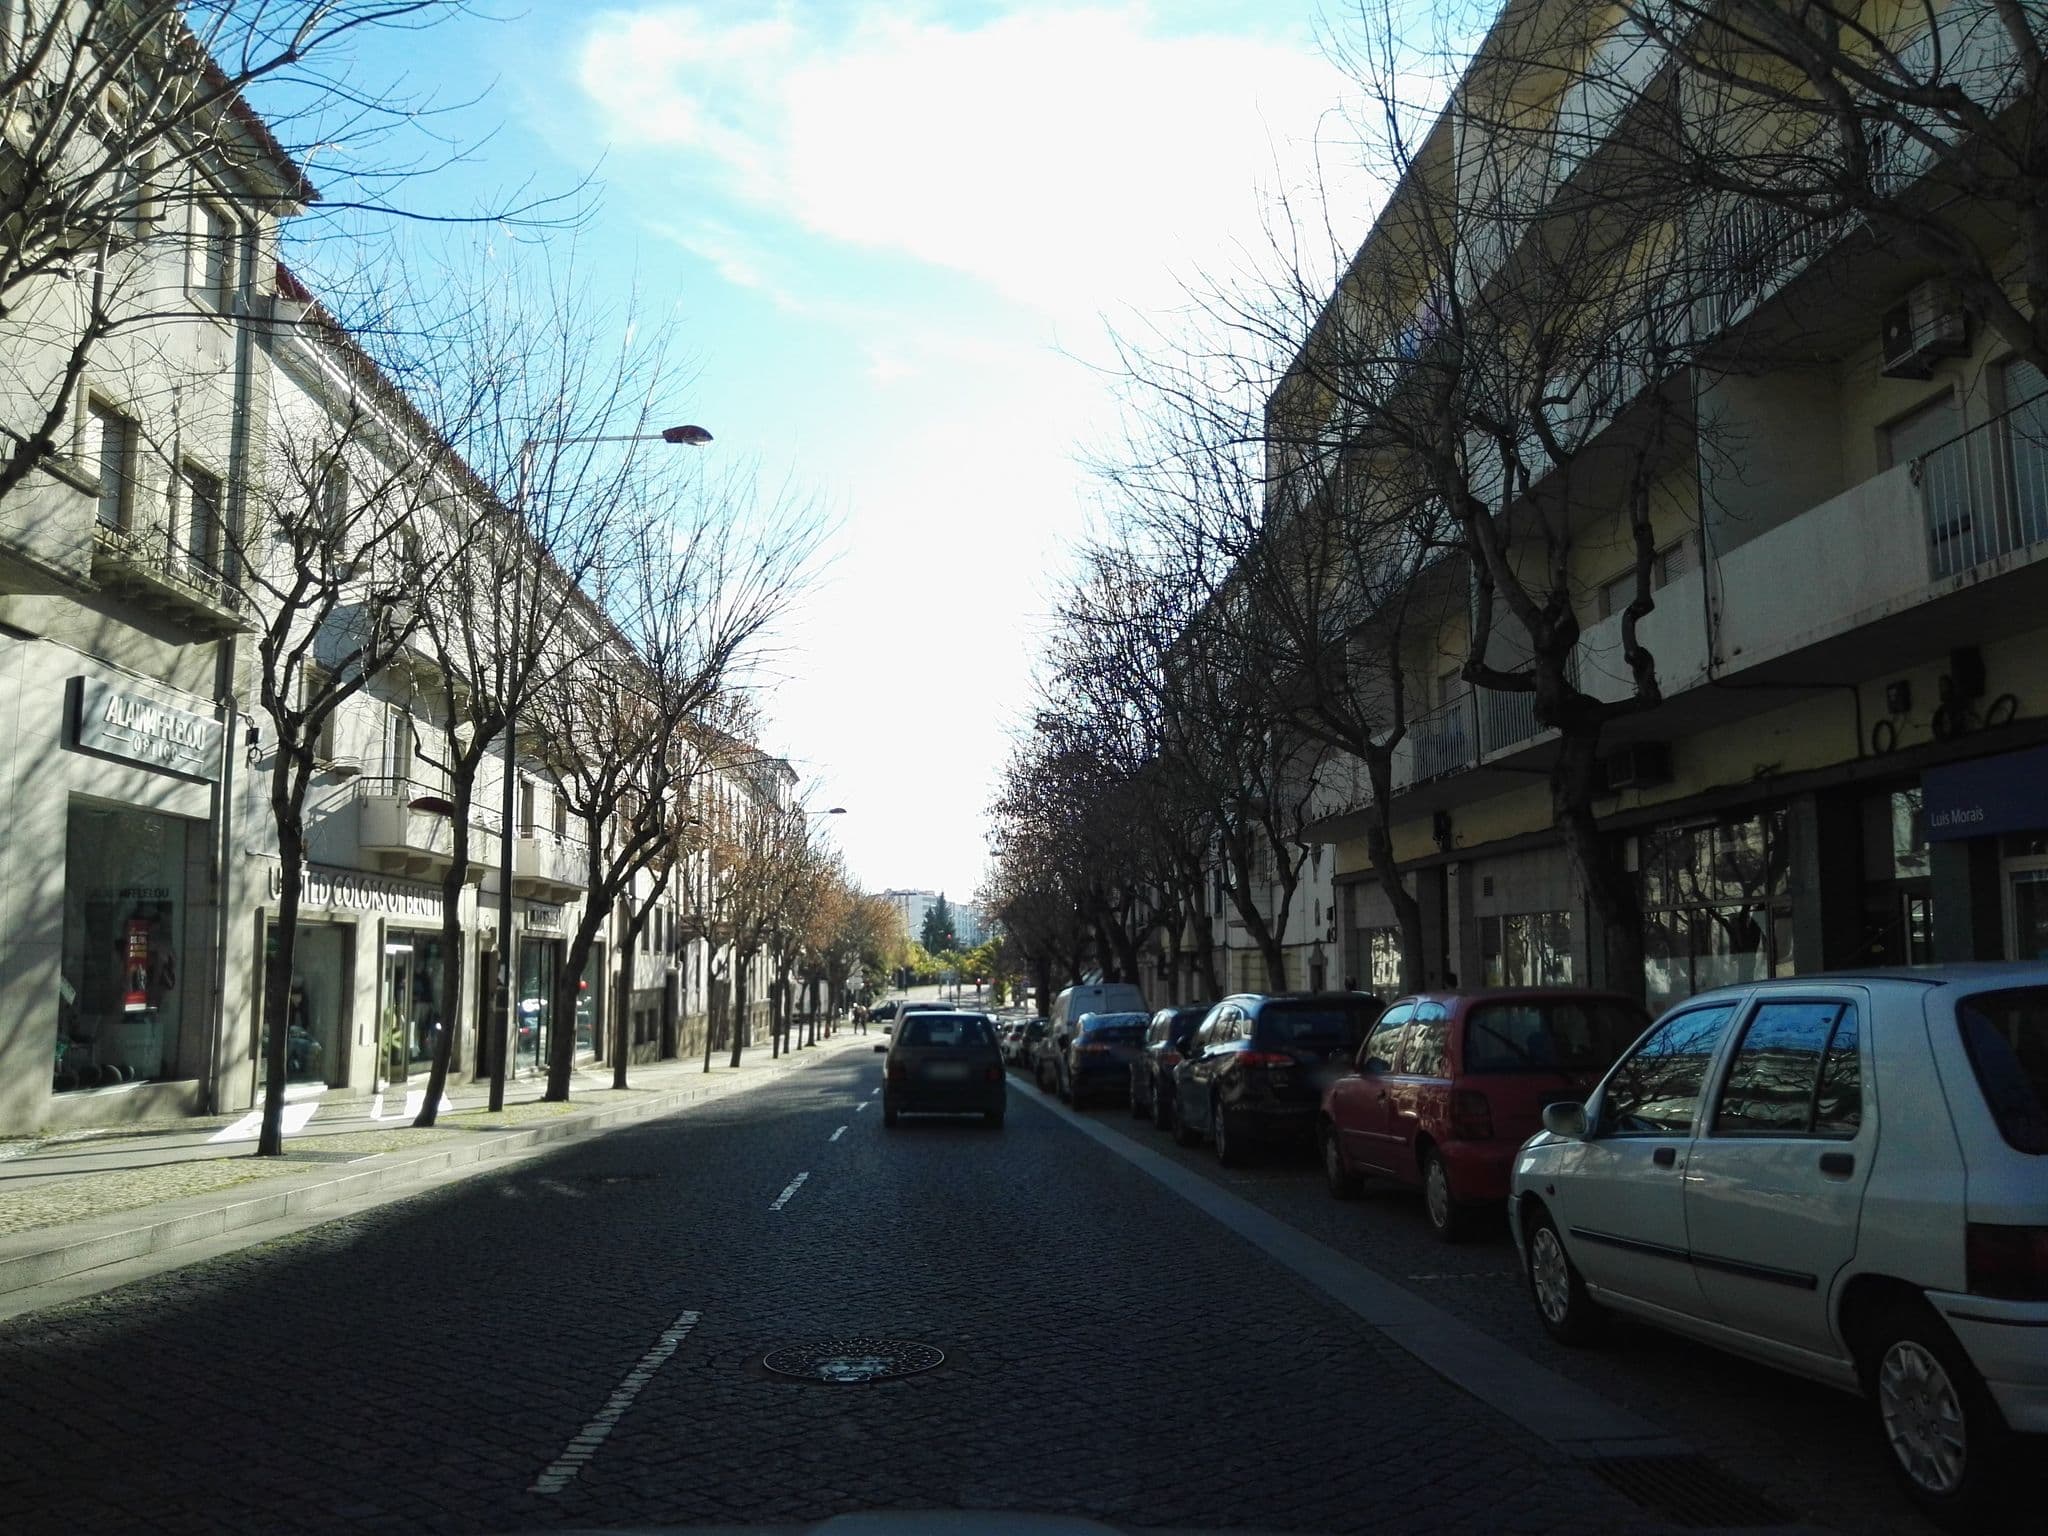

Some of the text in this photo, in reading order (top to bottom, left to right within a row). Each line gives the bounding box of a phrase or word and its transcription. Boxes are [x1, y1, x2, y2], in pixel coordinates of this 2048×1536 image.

[1931, 805, 1984, 827] Luis Morais
[268, 866, 331, 905] UTED
[332, 874, 388, 912] COLORS
[388, 882, 407, 914] OF
